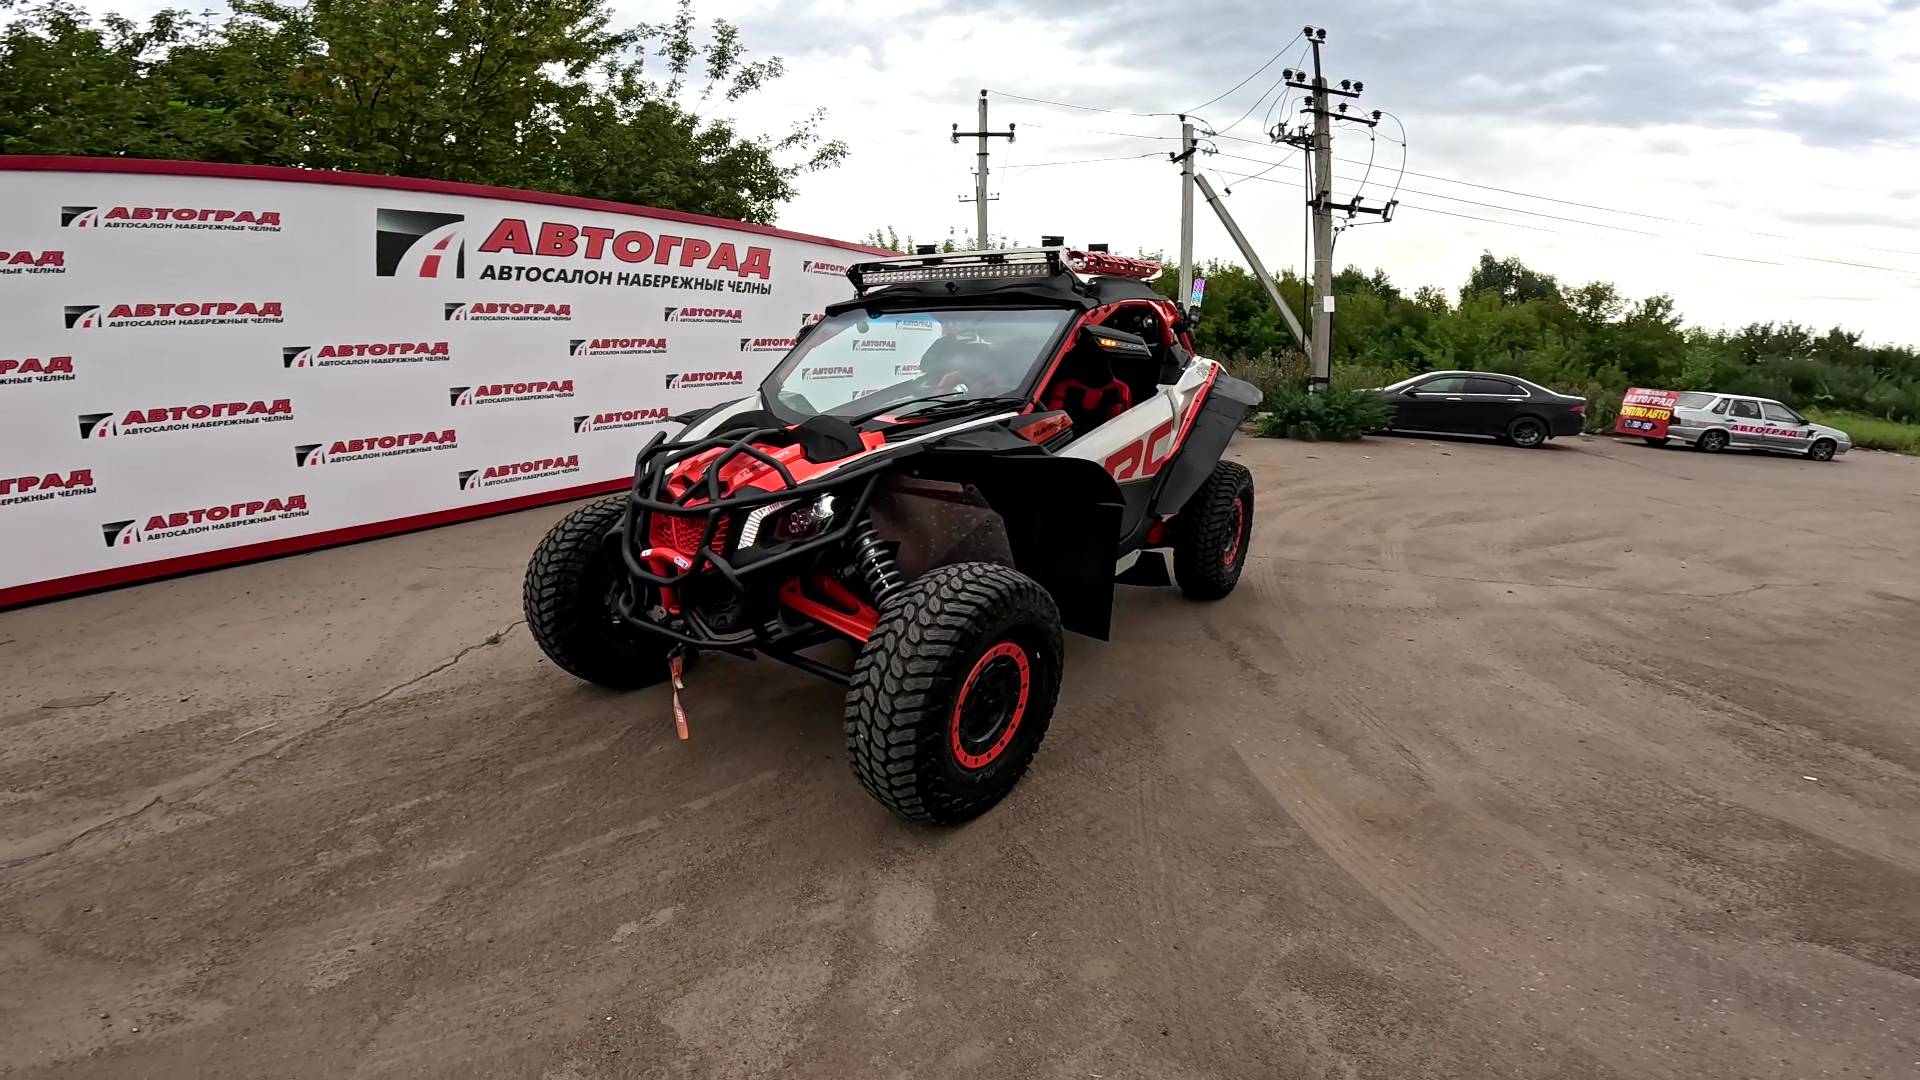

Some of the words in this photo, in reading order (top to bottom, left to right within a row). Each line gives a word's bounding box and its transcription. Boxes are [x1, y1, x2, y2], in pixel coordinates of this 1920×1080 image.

[104, 207, 281, 225] АВТОГРАД
[175, 223, 246, 231] НАБЕРЕЖНЫЕ
[478, 218, 772, 280] АВТОГРАД
[814, 262, 847, 273] АВТОГР
[479, 264, 613, 286] АВТОСАЛОН
[616, 272, 725, 292] НАБЕРЕЖНЫЕ
[727, 280, 772, 296] ЧЕЛНЫ
[107, 302, 282, 318] АВТОГРАД
[470, 303, 571, 315] АВТОГРАД
[680, 307, 742, 319] АВТОГРАД
[178, 318, 248, 326] НАБЕРЕЖНЫЕ
[317, 342, 449, 358] АВТОГРАД
[589, 338, 667, 349] АВТОГРАД
[753, 338, 798, 347] АВТОГРА
[318, 359, 369, 367] АВТОСАЛОН
[36, 374, 76, 382] ЧЕЛНЫ
[681, 371, 743, 382] АВТОГРАД
[474, 380, 574, 397] АВТОГРАД
[121, 398, 292, 425] АВТОГРАД
[593, 407, 669, 424] АВТОГРАД
[124, 424, 189, 436] АВТОСАЛОН
[192, 417, 260, 429] НАБЕРЕЖНЫЕ
[262, 414, 294, 423] ЧЕЛНЫ
[1730, 424, 1798, 437] АВТОГРАД
[328, 429, 456, 455] АВТОГРАД
[330, 453, 380, 463] АВТОСАЛОН
[381, 446, 432, 457] НАБЕРЕЖНЫЕ
[483, 454, 579, 479] АВТОГРАД
[0, 492, 55, 506] ЕРЕЖНЫЕ
[58, 487, 97, 497] ЧЕЛНЫ
[144, 494, 307, 531] АВТОГРАД
[147, 526, 210, 541] АВТОСАЛОН
[211, 515, 276, 531] НАБЕРЕЖНЫЕ
[278, 510, 309, 520] ЧЕЛНЫ
